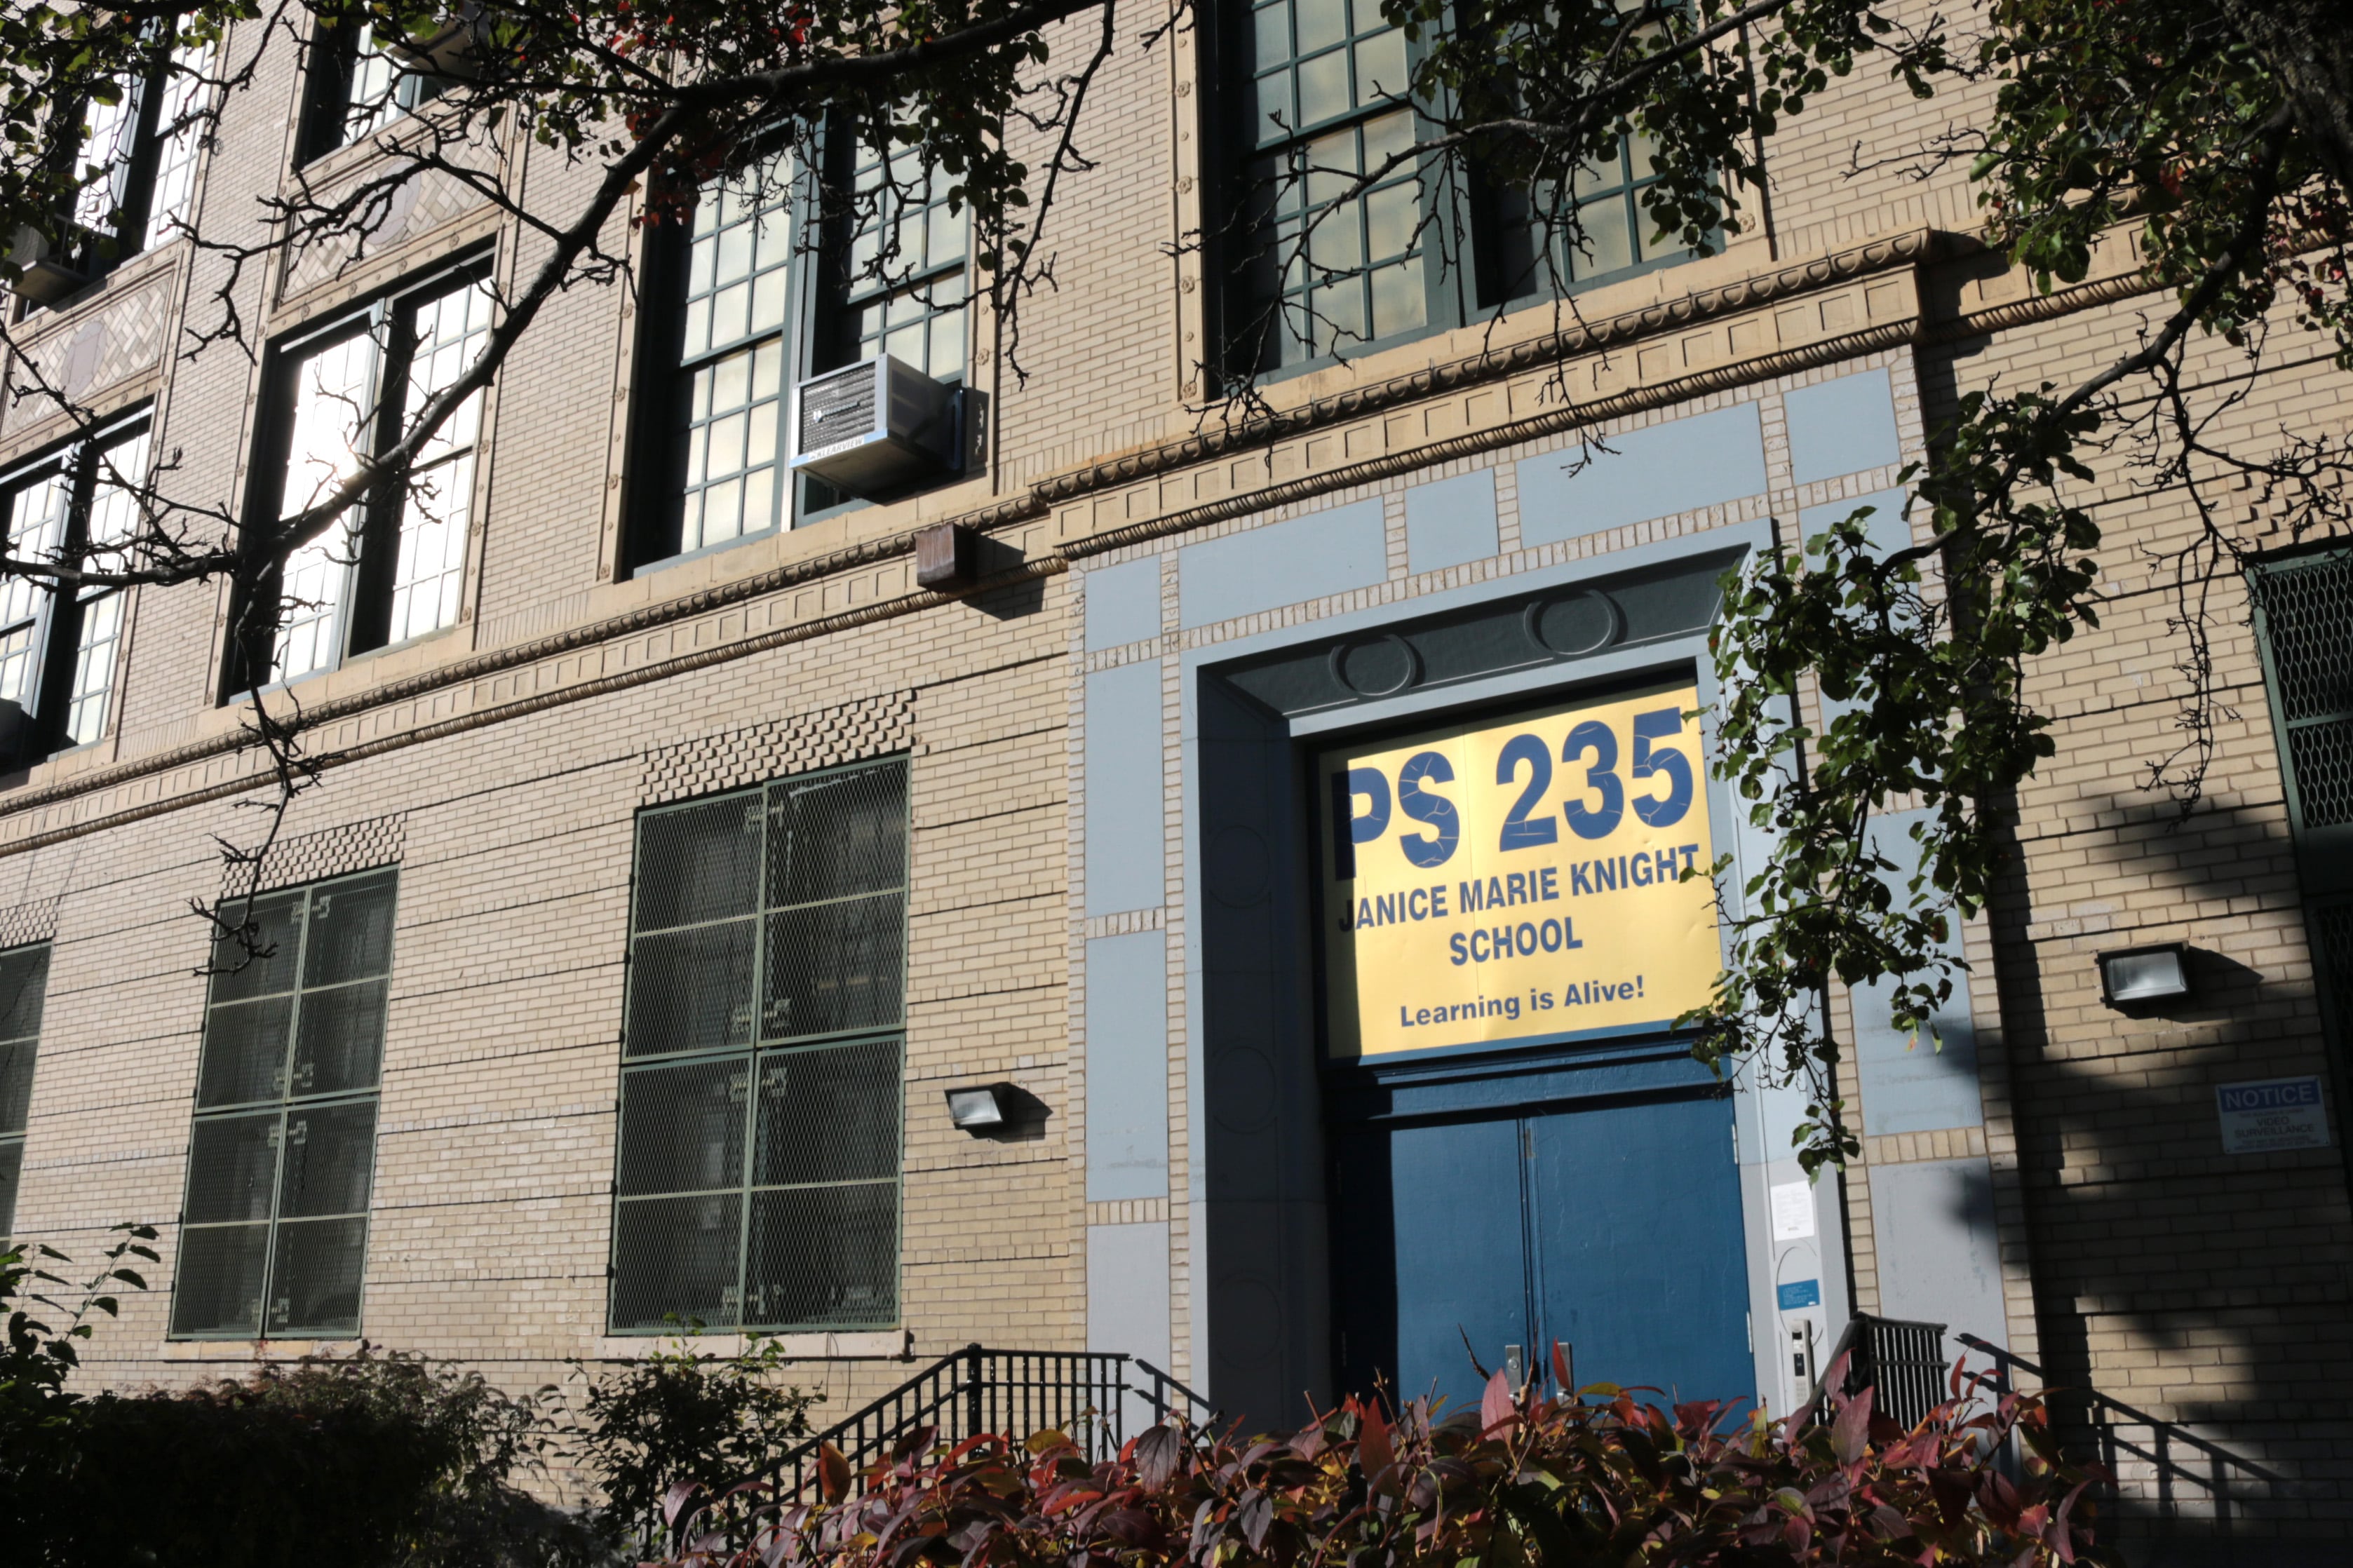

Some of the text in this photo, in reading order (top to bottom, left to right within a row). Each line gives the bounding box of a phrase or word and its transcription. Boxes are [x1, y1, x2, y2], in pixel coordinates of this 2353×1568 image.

[816, 437, 863, 459] KLEARVIEW
[1331, 707, 1693, 881] PS 235
[1339, 844, 1699, 932] JANICE MARIE KNIGHT
[1450, 917, 1583, 966] SCHOOL
[1401, 975, 1645, 1027] Learning is Alive!
[2225, 1085, 2314, 1109] NOTICE
[2234, 1124, 2314, 1138] SURVEILLANCE
[2256, 1116, 2289, 1126] VIDEO
